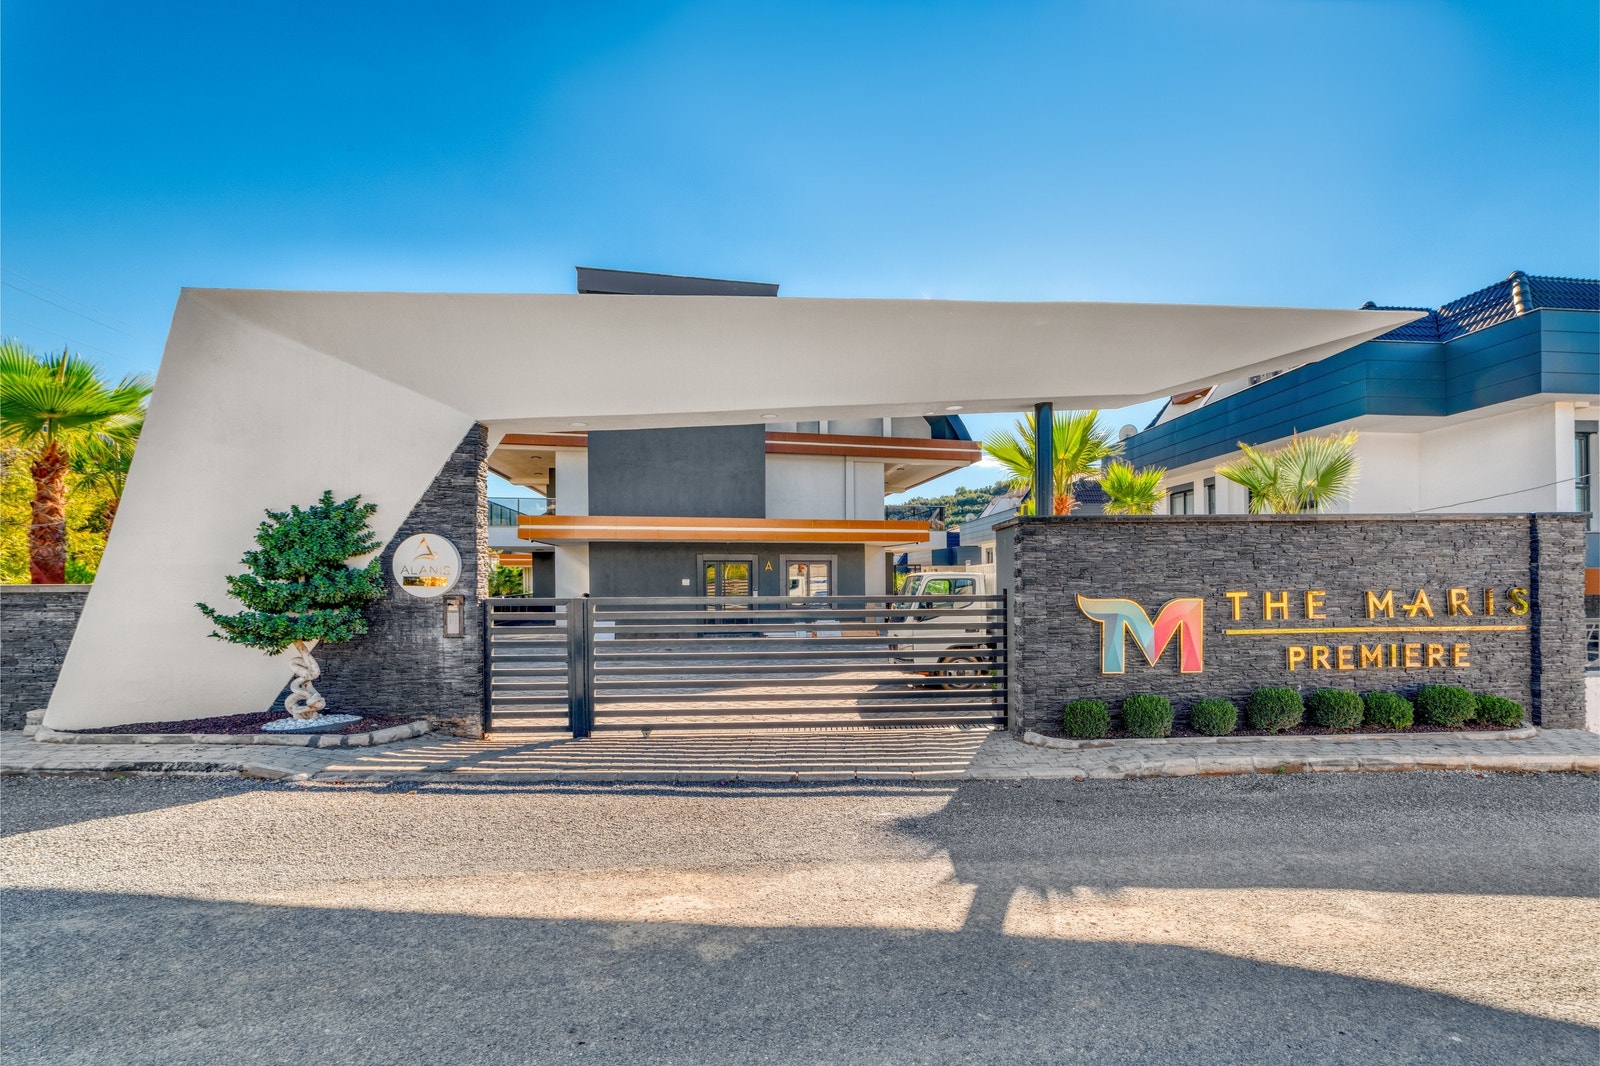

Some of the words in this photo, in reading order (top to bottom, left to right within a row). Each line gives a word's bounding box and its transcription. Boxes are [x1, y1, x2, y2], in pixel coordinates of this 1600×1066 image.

[400, 565, 451, 576] ALANIS
[1224, 589, 1327, 620] THE
[1364, 587, 1529, 619] MARIS
[1286, 643, 1471, 671] PREMIERE
